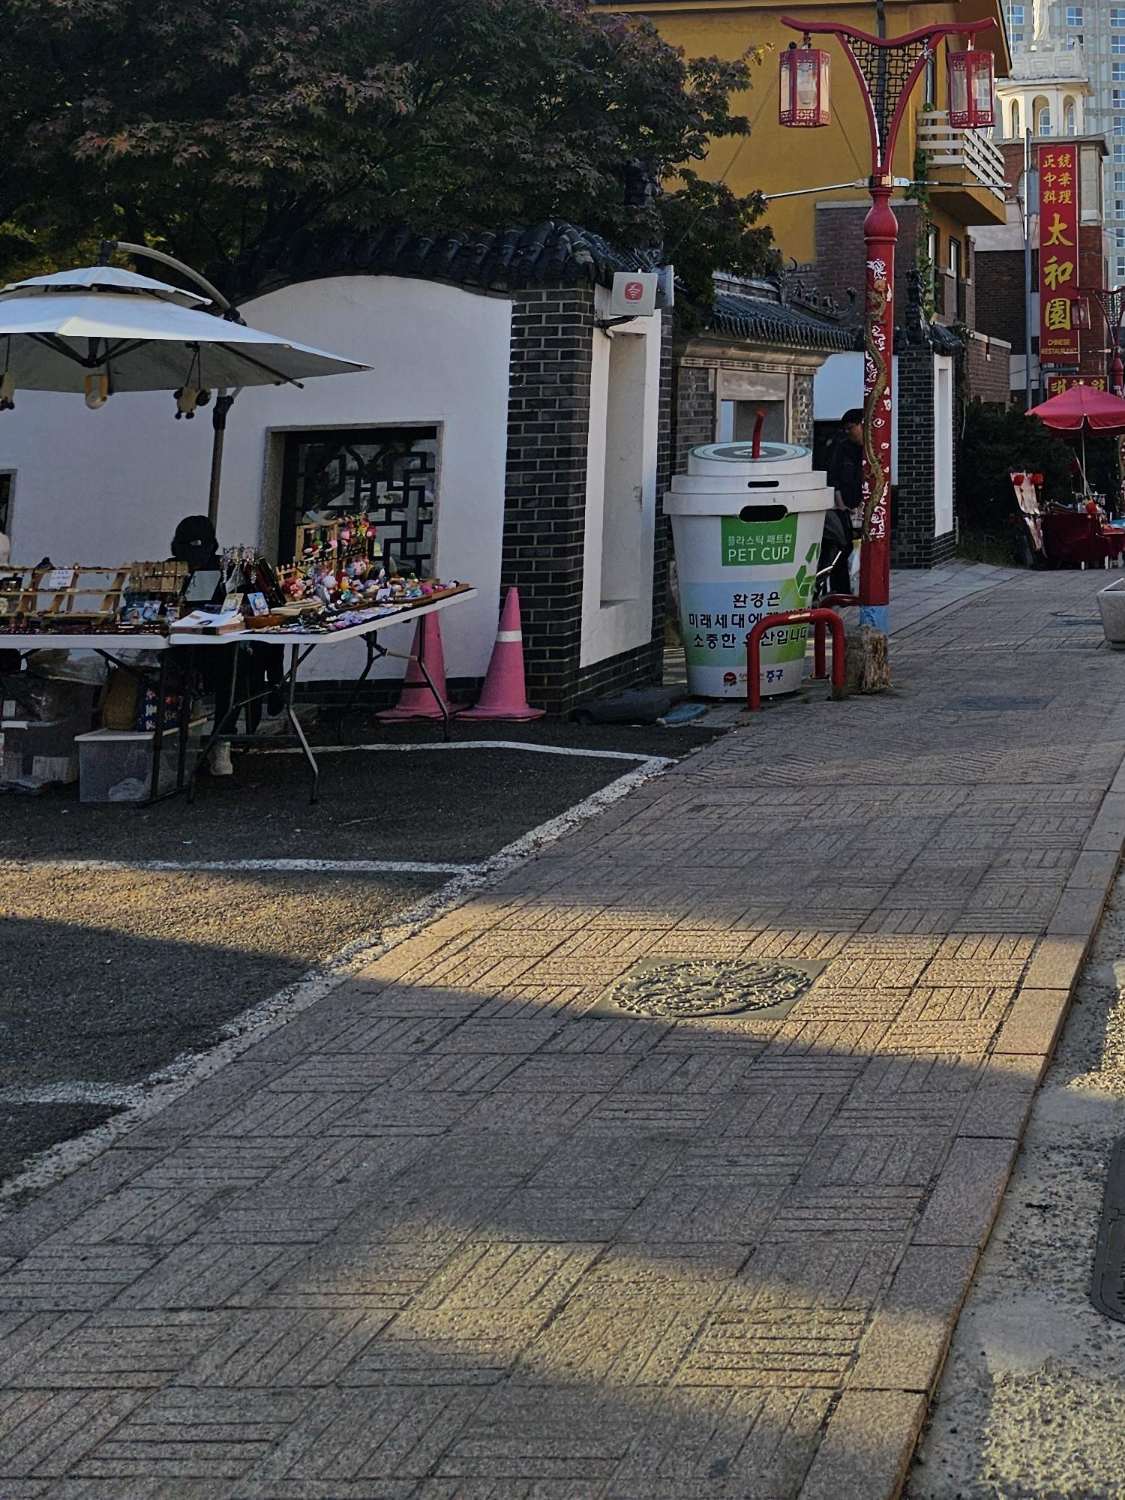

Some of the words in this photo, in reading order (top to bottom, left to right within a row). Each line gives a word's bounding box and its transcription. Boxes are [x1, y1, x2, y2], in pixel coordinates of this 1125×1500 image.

[1043, 153, 1072, 168] 正統
[1043, 172, 1072, 187] 中華
[1043, 190, 1072, 204] 料理
[1042, 213, 1075, 331] 太和園
[728, 535, 764, 546] 플라스틱
[728, 548, 757, 561] PET
[761, 546, 790, 560] CUP
[732, 591, 780, 608] 환경은
[693, 633, 736, 649] 소중한
[766, 669, 784, 683] 중구
